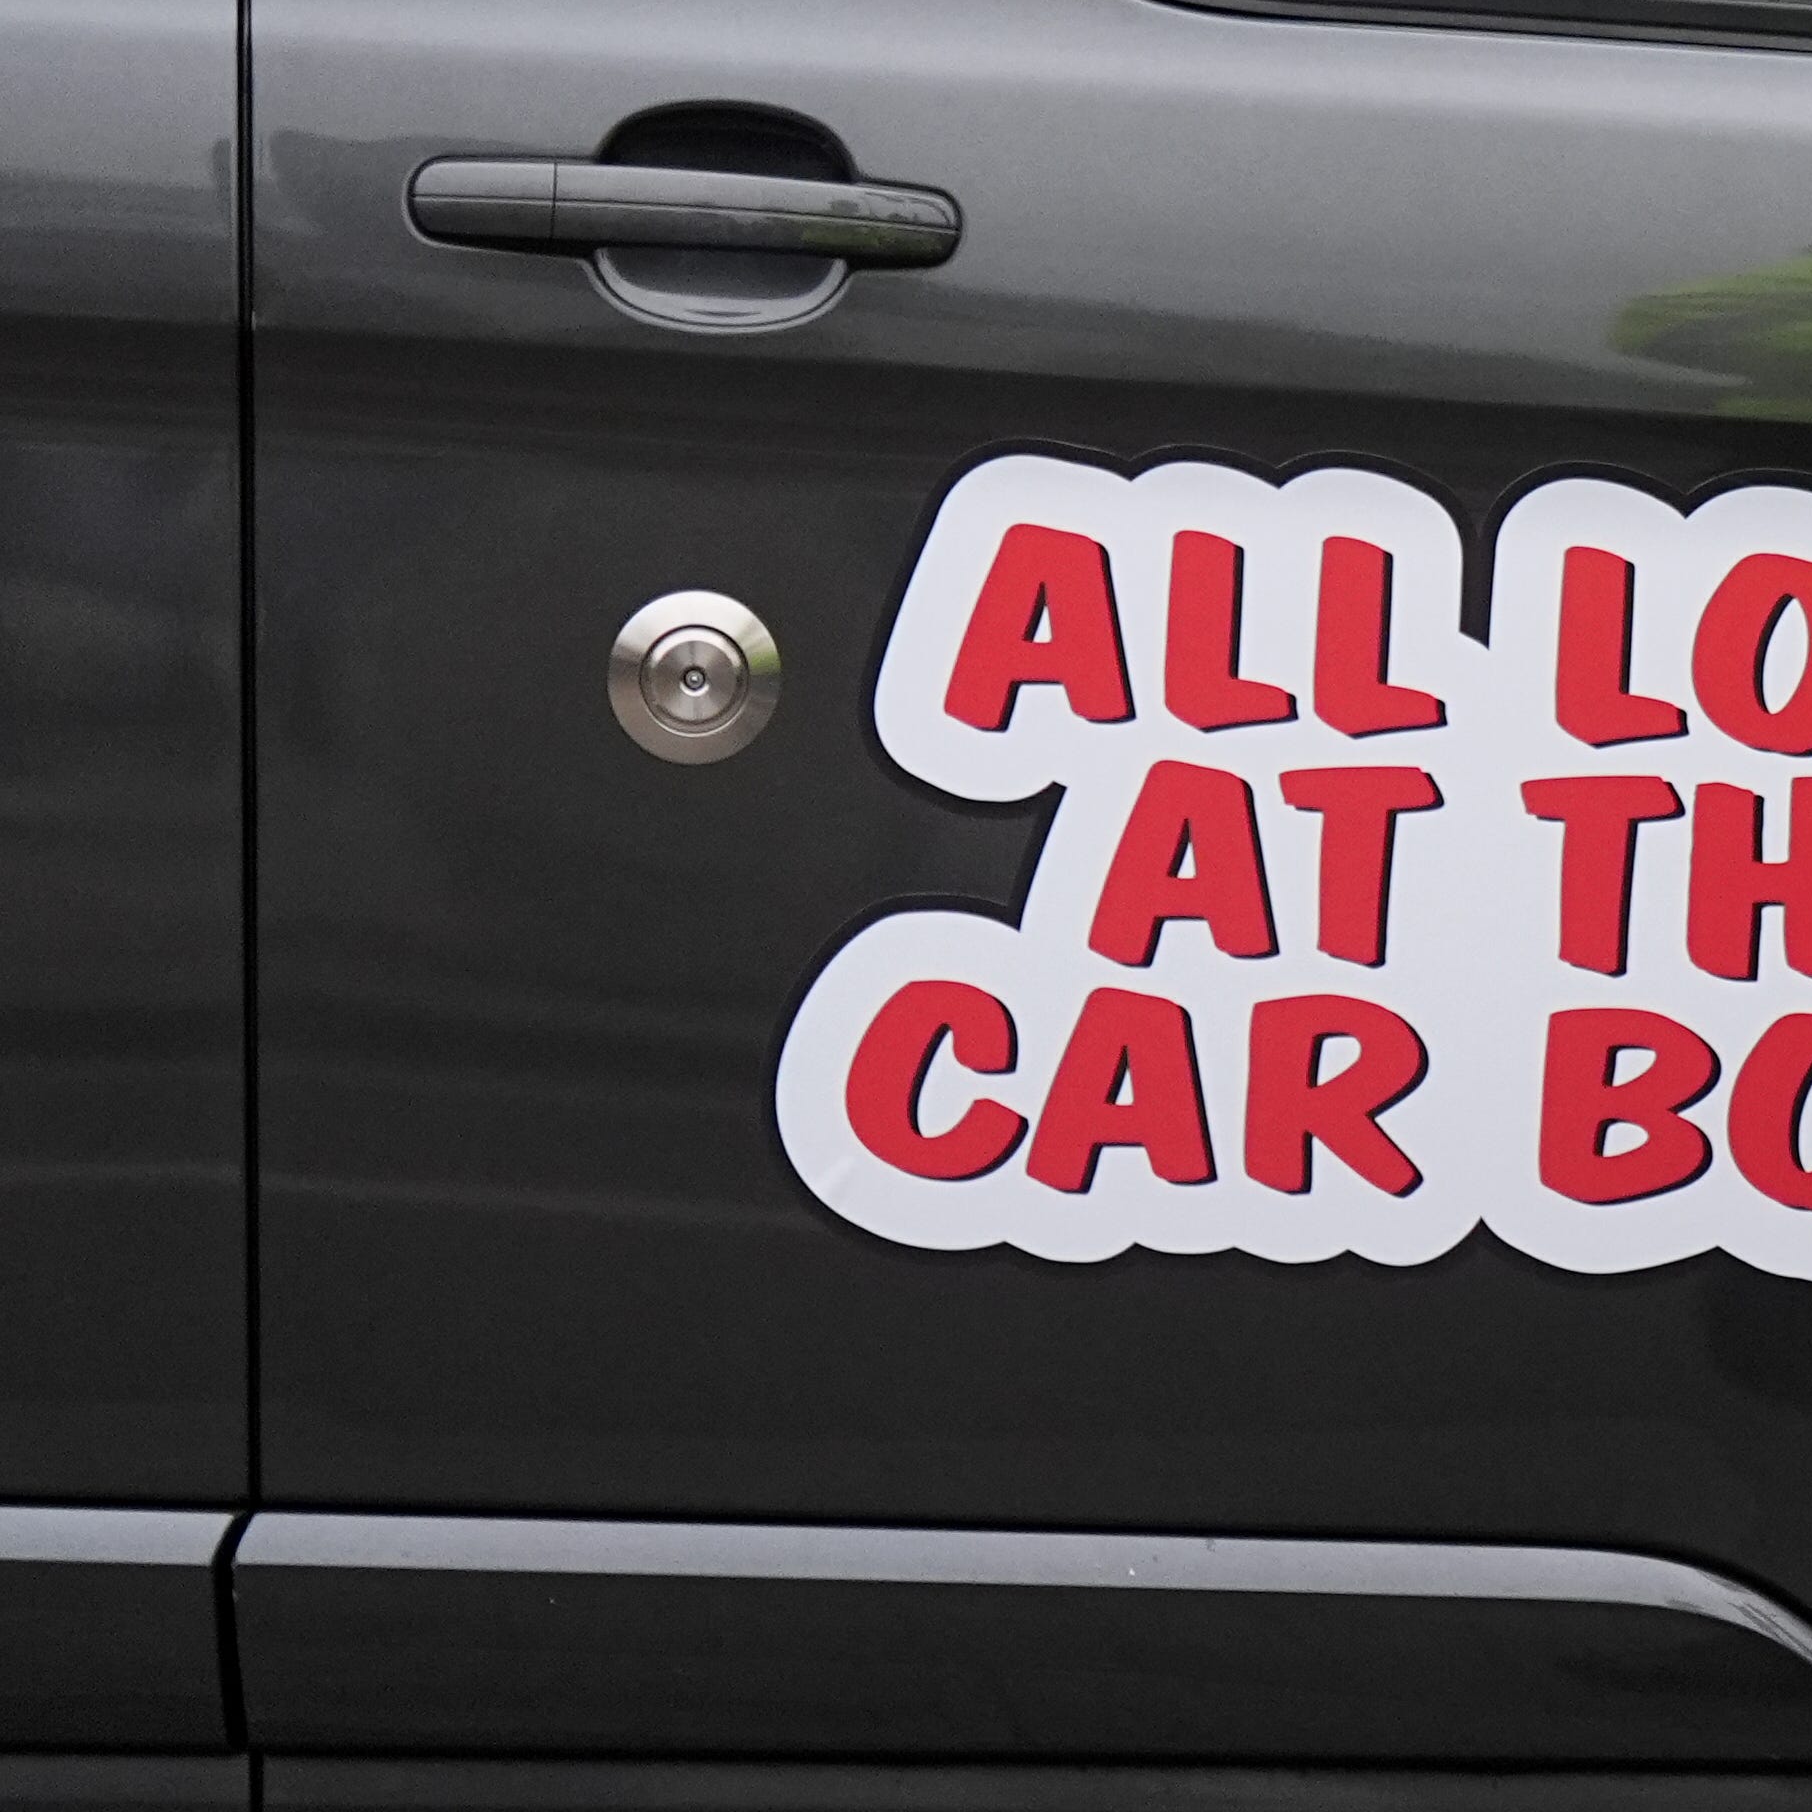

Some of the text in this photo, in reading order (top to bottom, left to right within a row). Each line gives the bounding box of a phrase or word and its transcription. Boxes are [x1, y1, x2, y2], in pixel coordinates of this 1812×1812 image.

[944, 524, 1446, 738] ALL
[1089, 760, 1443, 968] AT
[845, 980, 1428, 1196] CAR
